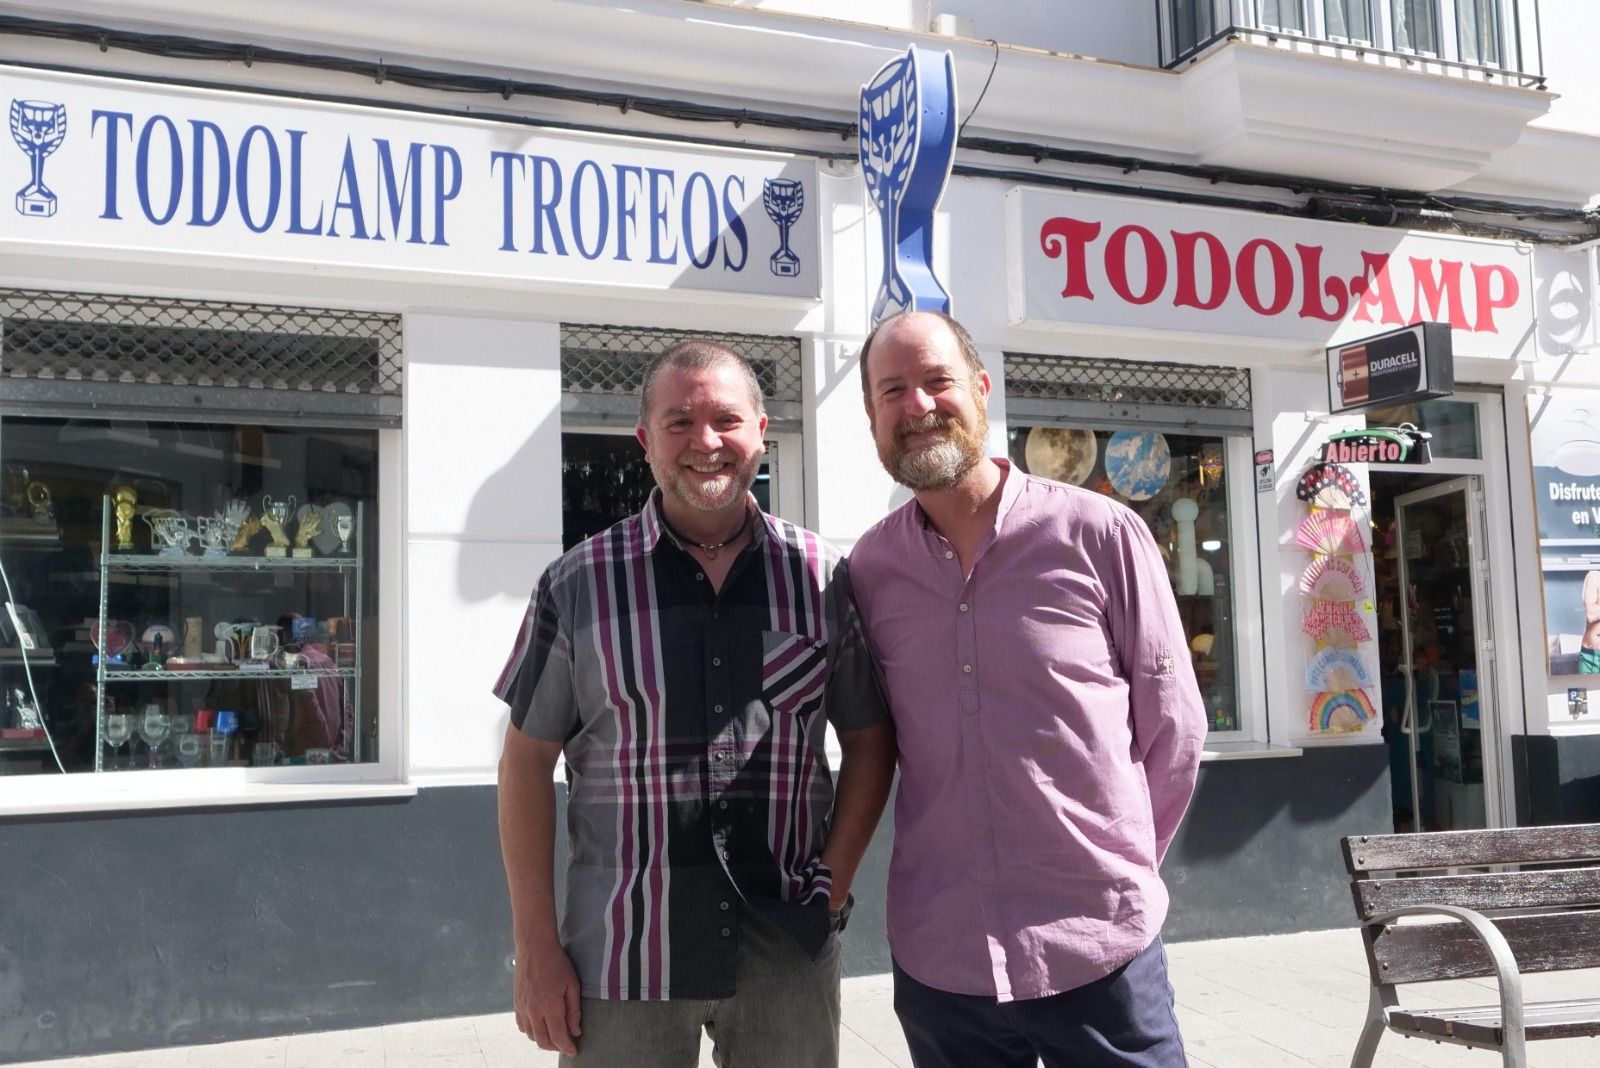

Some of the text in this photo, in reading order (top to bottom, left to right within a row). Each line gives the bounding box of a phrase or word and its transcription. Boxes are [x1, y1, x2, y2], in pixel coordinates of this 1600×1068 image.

[91, 110, 750, 273] TODOLAMP TROFEOS
[1040, 216, 1520, 334] TODOLAMP
[1370, 351, 1418, 372] DURACELL
[1325, 440, 1400, 463] Abierto
[1571, 511, 1590, 525] en
